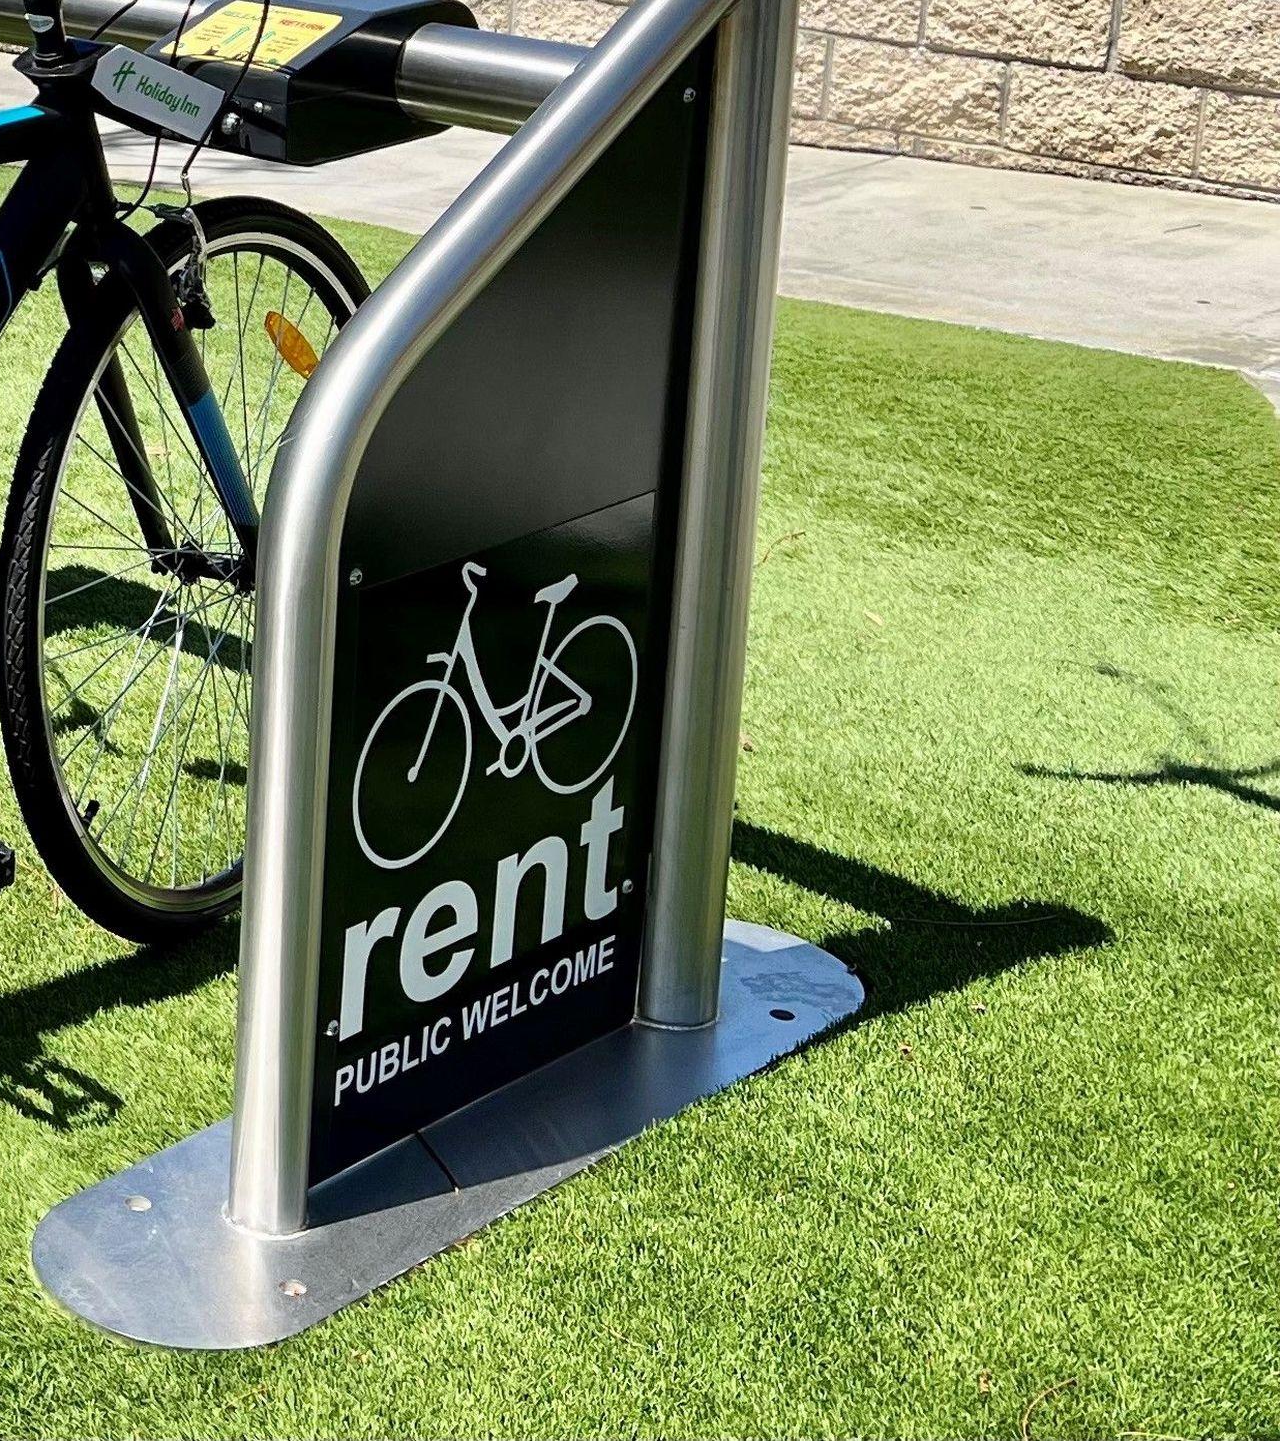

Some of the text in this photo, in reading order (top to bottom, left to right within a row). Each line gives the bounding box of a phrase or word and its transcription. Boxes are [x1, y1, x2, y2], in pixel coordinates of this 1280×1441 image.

[135, 74, 182, 113] Holiday
[180, 94, 201, 118] Inn
[339, 774, 625, 1043] rent
[333, 934, 616, 1107] PUBLIC WELCOME
